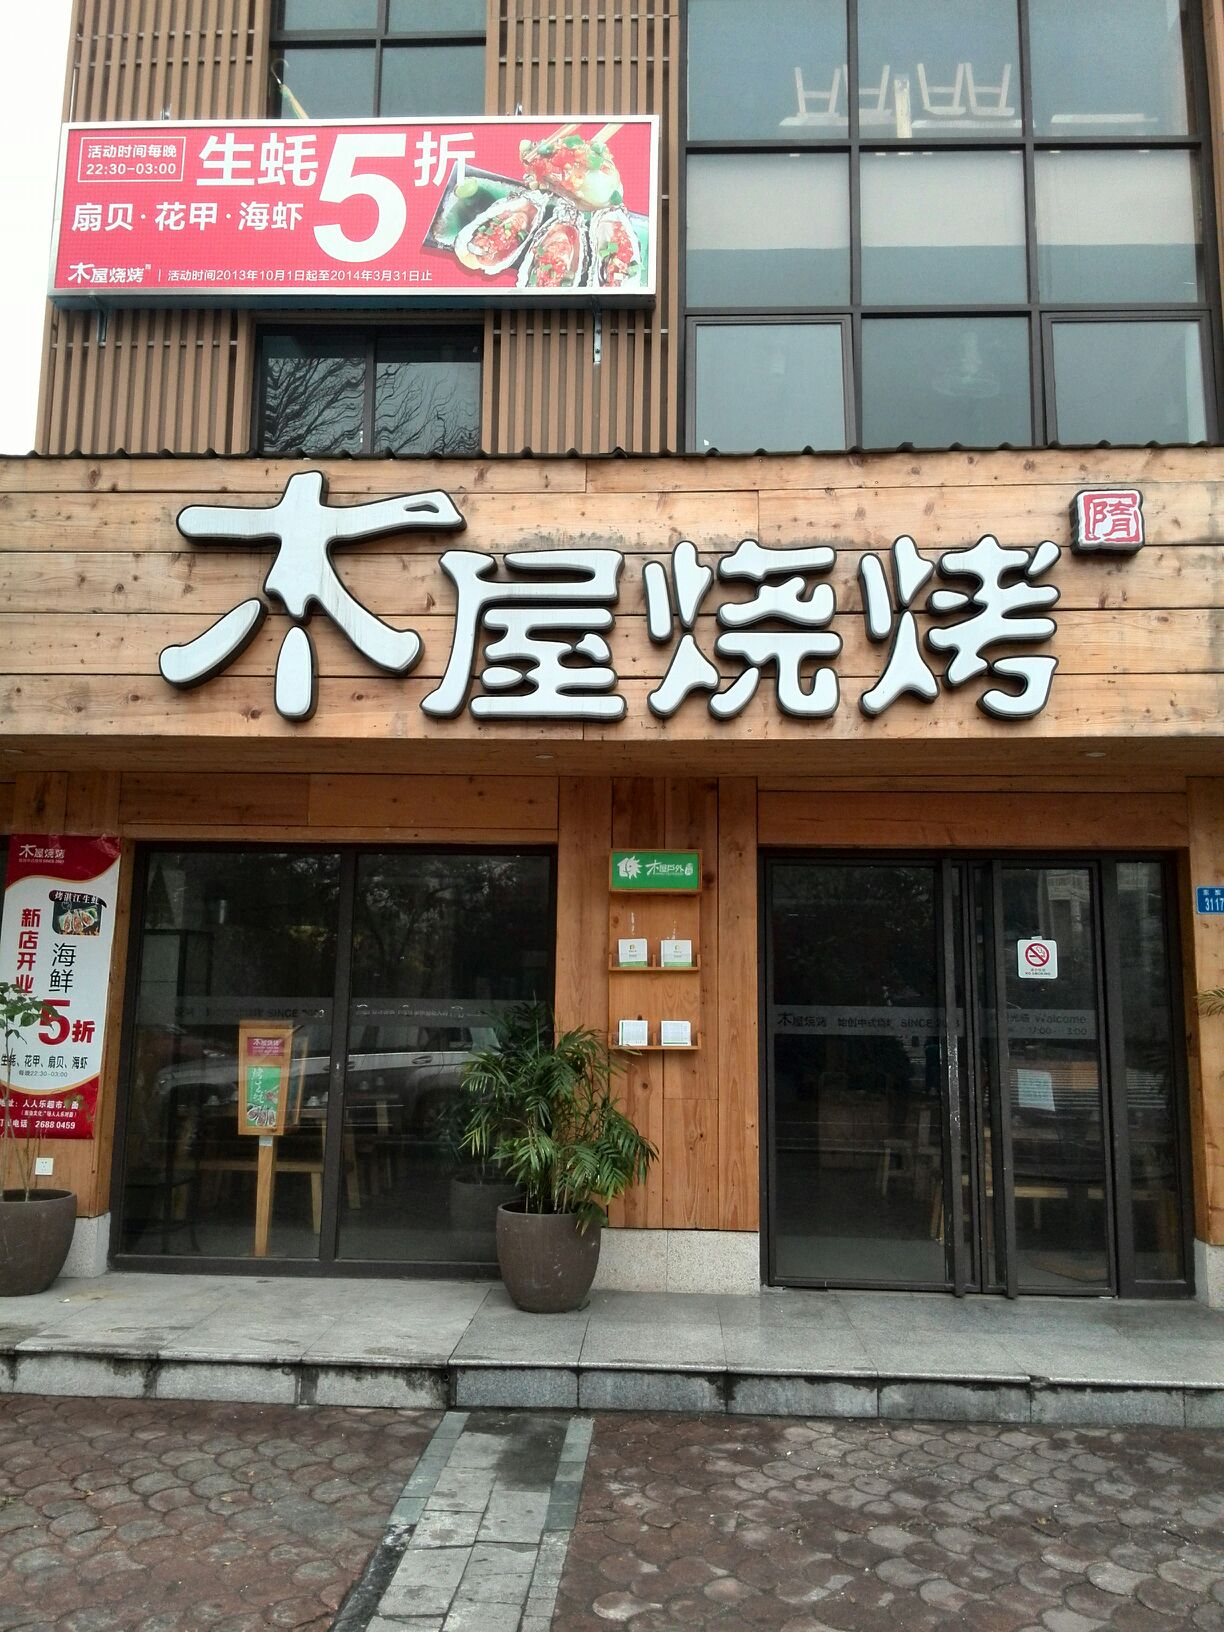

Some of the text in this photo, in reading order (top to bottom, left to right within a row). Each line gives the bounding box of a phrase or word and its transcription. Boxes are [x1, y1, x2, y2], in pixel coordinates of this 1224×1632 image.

[87, 144, 178, 158] 活动时间每晚
[85, 162, 177, 176] 22:30-03:00
[67, 262, 145, 284] 木屋烧烤
[167, 268, 433, 283] 活动时间2013年10月1日起至2014年3月31日止
[158, 470, 1062, 724] 木屋烧烤
[19, 844, 65, 859] 木屋烧烤
[16, 908, 42, 995] 新店开业
[48, 943, 77, 994] 海鲜
[22, 1099, 79, 1110] 人人乐超市面
[35, 1120, 55, 1129] 2688
